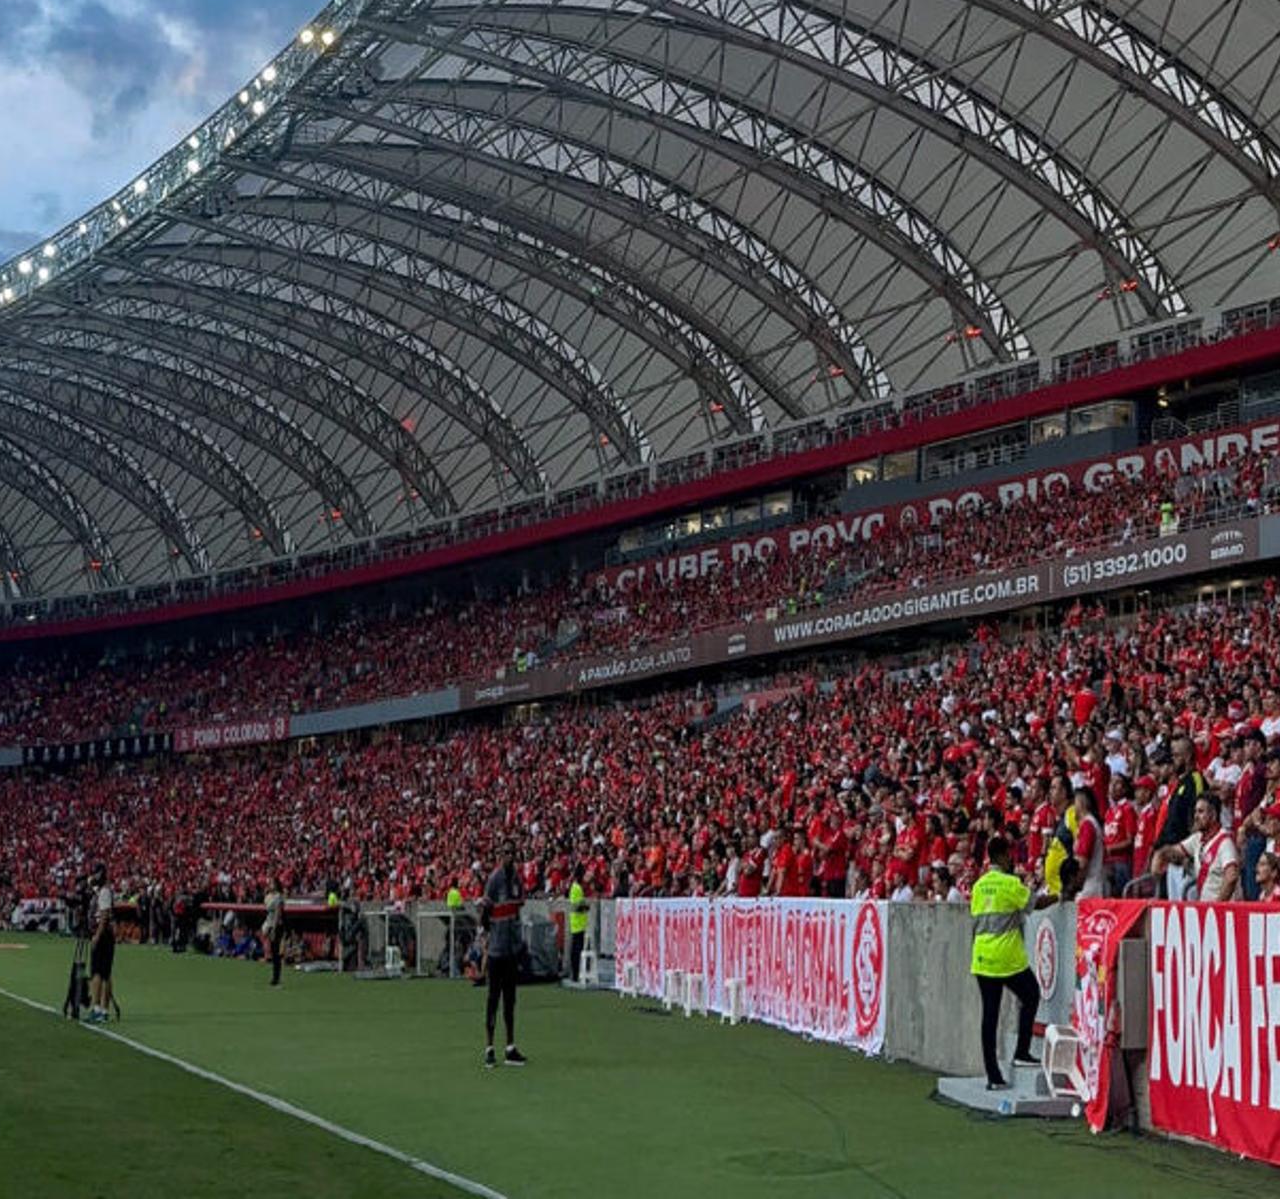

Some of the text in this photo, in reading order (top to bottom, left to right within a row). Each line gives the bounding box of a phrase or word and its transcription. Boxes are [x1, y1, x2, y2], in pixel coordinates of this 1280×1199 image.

[1082, 424, 1280, 493] GRANDE
[774, 575, 1039, 643] WWW.CORACAODOGIGANTE.COM.BR
[1093, 544, 1187, 579] 3392.1000
[1150, 906, 1243, 1137] FORÇA
